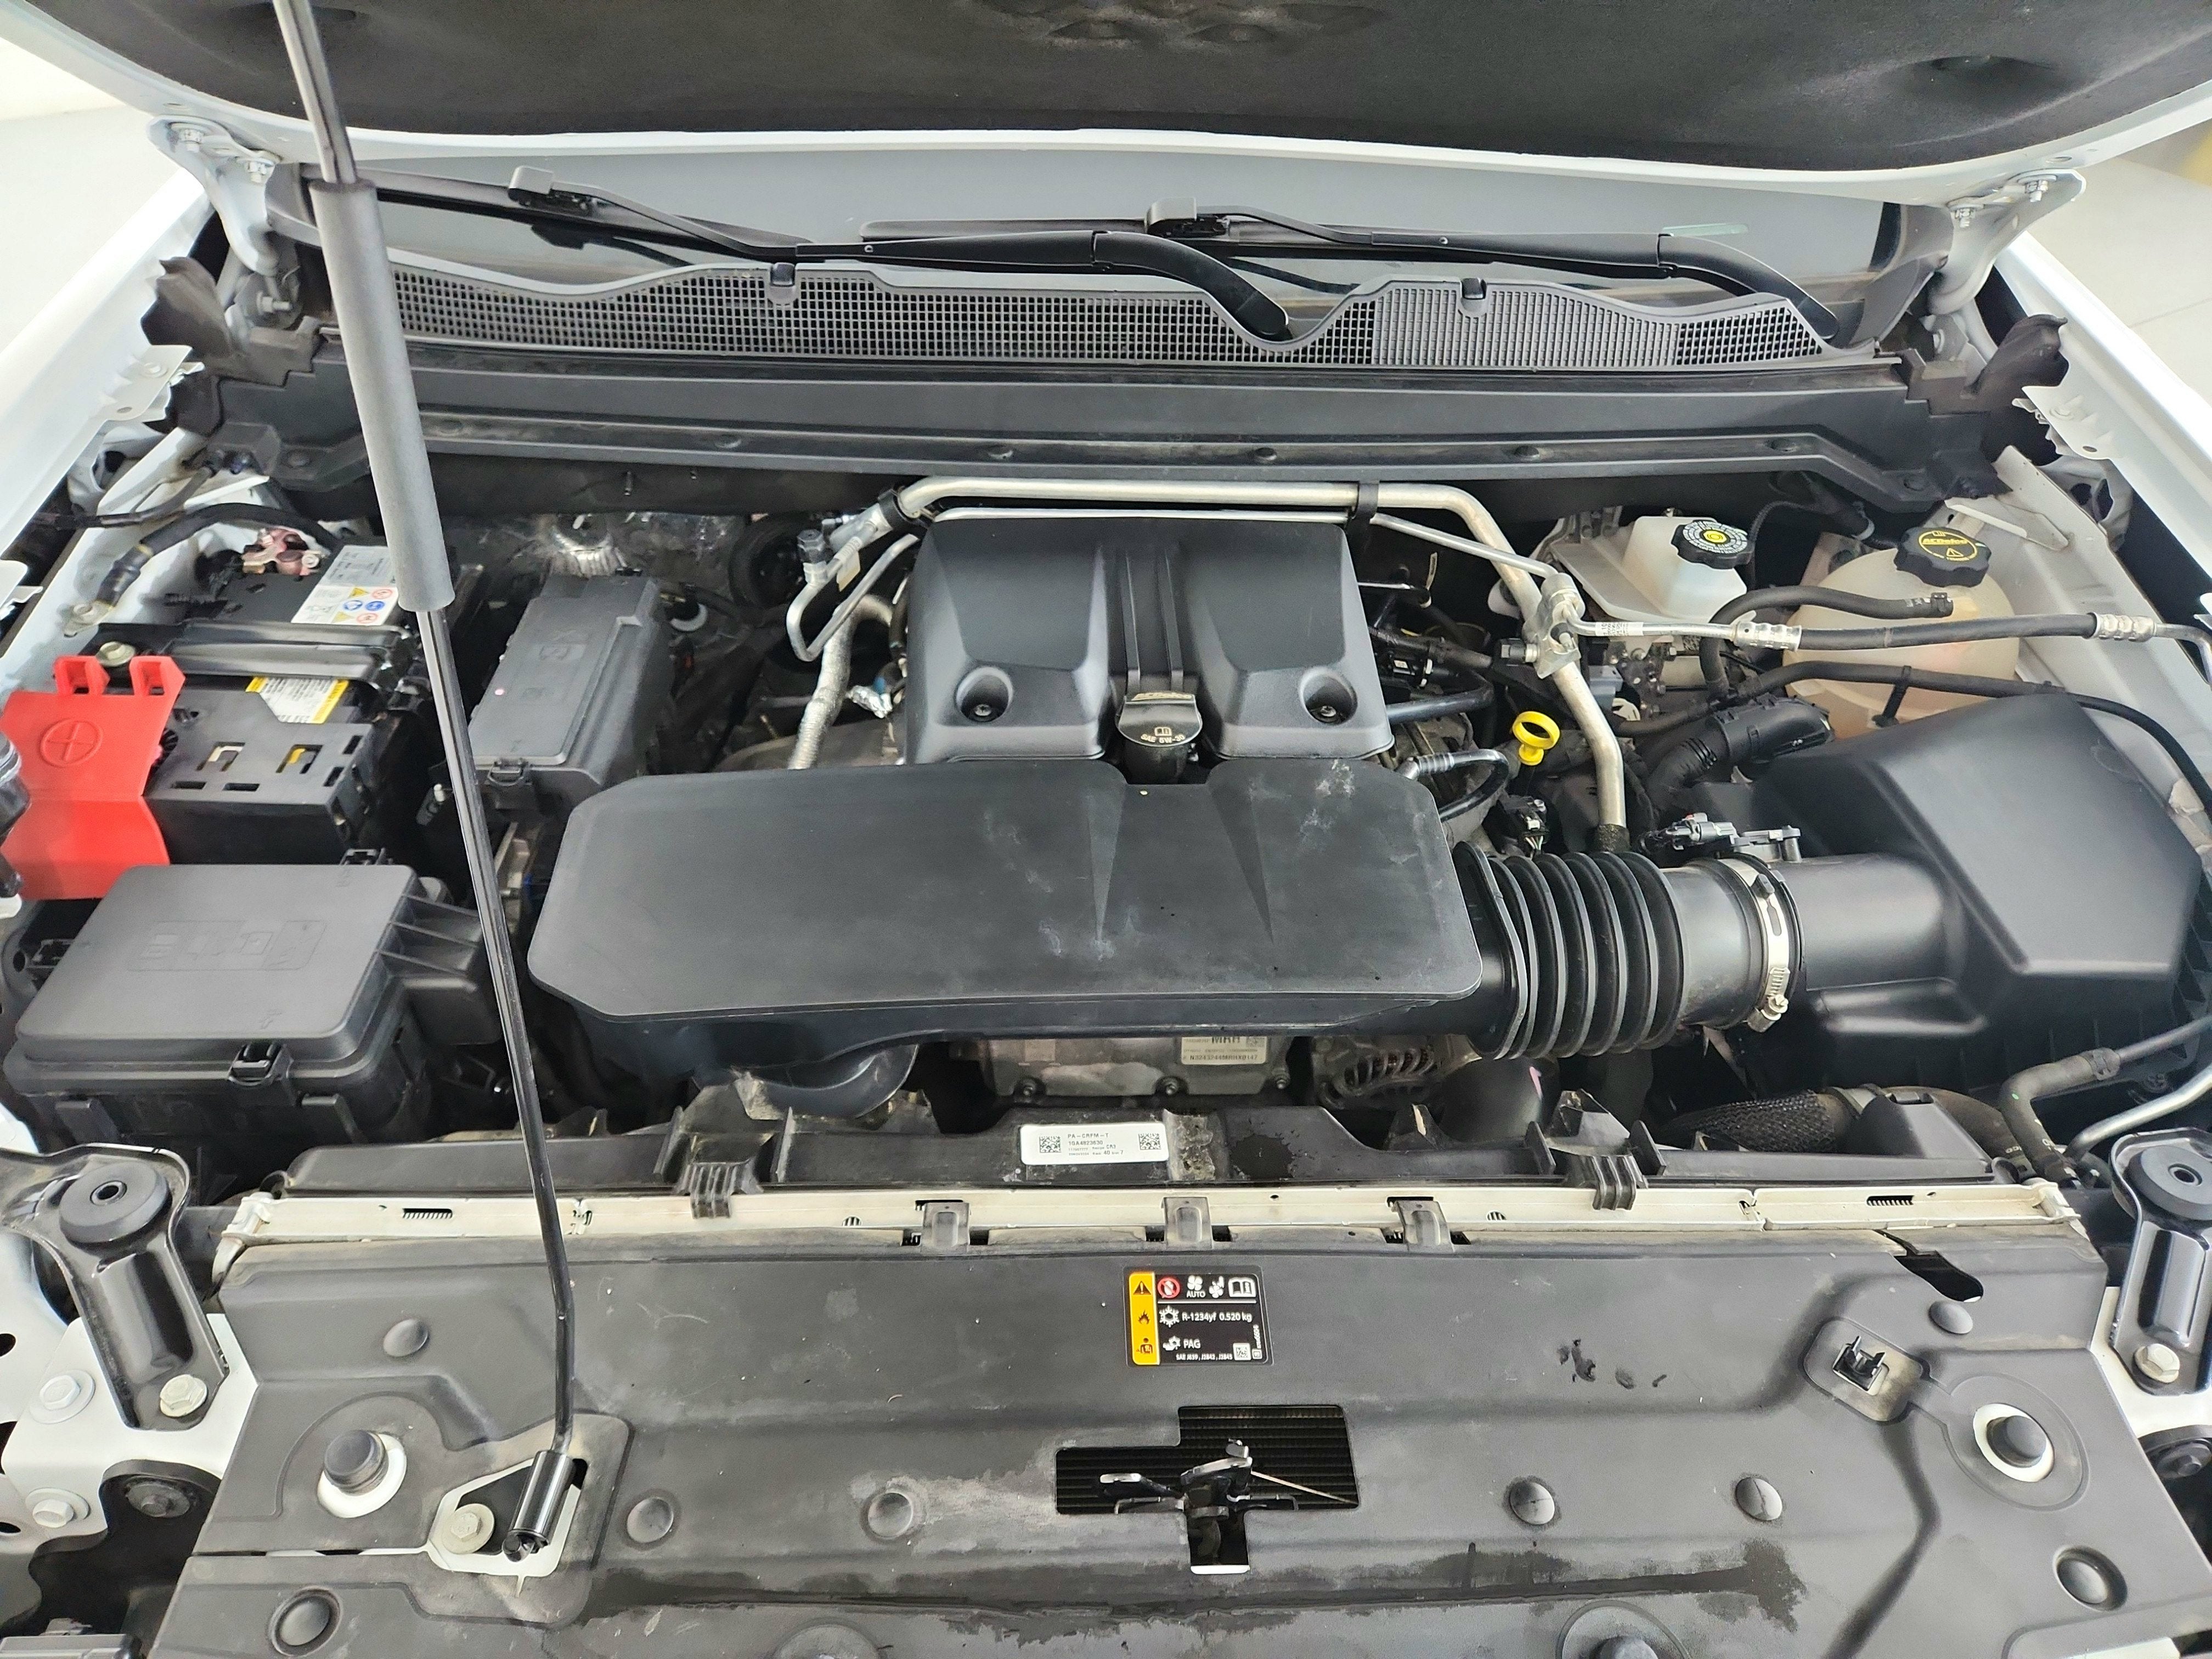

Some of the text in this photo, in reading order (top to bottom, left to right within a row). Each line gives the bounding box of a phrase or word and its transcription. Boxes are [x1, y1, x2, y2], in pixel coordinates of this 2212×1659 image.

[1141, 733, 1186, 743] SAE 5W-30
[1182, 1311, 1252, 1323] R-1234yf 0.520 kg
[1183, 1339, 1201, 1349] PAG
